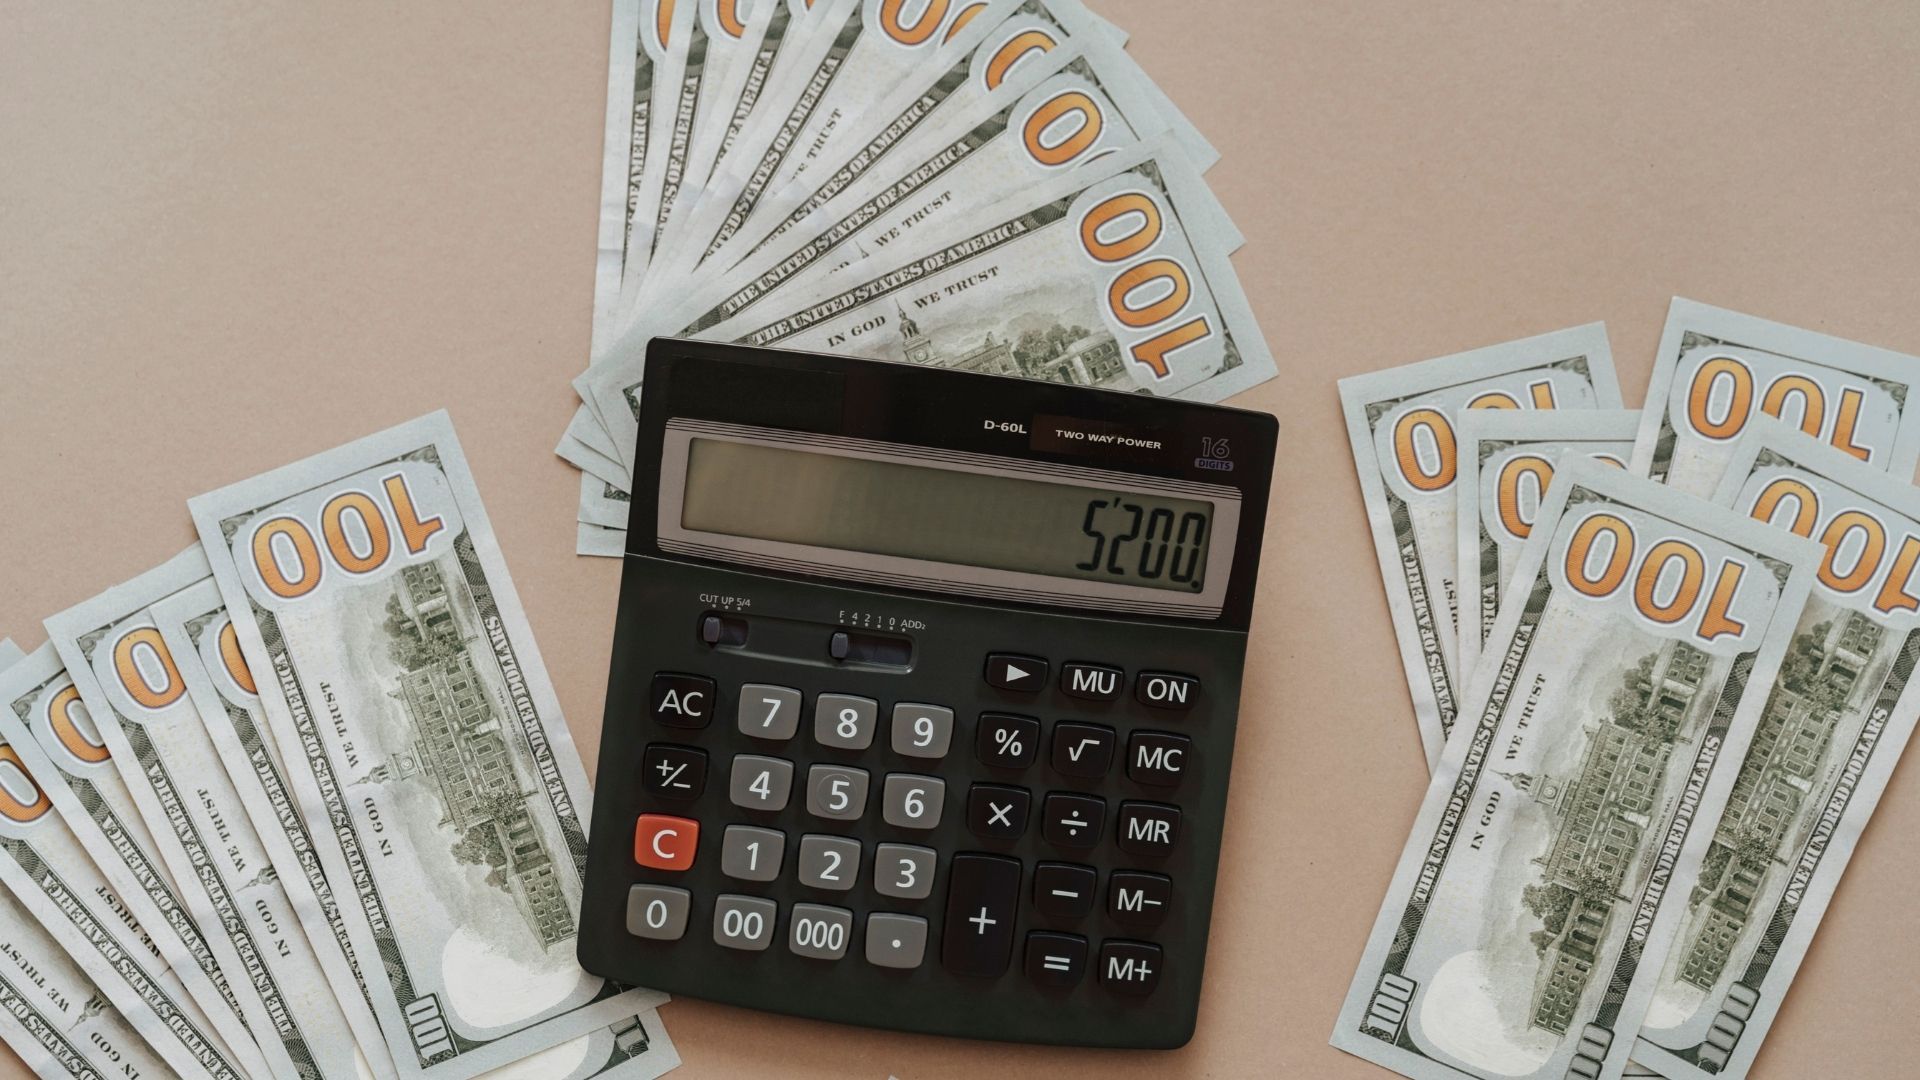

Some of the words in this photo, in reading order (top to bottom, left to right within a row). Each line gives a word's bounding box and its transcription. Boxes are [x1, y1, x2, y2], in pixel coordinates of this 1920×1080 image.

[670, 76, 699, 162] AMERICA
[734, 150, 780, 214] STATES
[772, 127, 794, 153] OF
[785, 55, 840, 133] AMERICA
[806, 108, 842, 160] TRUST
[846, 151, 872, 175] OF
[865, 93, 935, 159] AMERICA
[723, 284, 759, 314] THE
[755, 243, 818, 292] UNITED
[813, 200, 881, 252] STATES
[875, 186, 900, 209] OF
[894, 138, 972, 197] AMERICA
[873, 226, 900, 248] WE
[901, 190, 953, 230] TRUST
[751, 320, 789, 345] THE
[787, 291, 855, 331] UNITED
[852, 260, 924, 303] STATES
[920, 251, 947, 272] OF
[943, 216, 1027, 263] AMERICA
[1081, 192, 1211, 378] 100
[826, 332, 846, 348] IN
[849, 314, 887, 338] GOD
[913, 290, 941, 310] WE
[943, 265, 1001, 297] TRUST
[984, 420, 1027, 434] D-60L
[1056, 429, 1084, 440] TWO
[1088, 433, 1115, 444] WAY
[1117, 437, 1162, 450] POWER
[1198, 459, 1231, 470] DIGITS
[1202, 437, 1230, 459] 16
[251, 473, 444, 598] 100
[1400, 542, 1432, 629] AMERICA
[1564, 512, 1745, 641] 100
[700, 594, 719, 603] CUT
[721, 596, 734, 605] UP
[737, 598, 750, 607] 5/4
[852, 612, 858, 620] 4
[864, 614, 871, 622] 2
[877, 616, 882, 624] 1
[889, 617, 895, 625] 0
[483, 614, 526, 700] DOLLARS
[1420, 627, 1437, 653] OF
[1072, 669, 1116, 694] MU
[1489, 620, 1533, 707] AMERICA
[272, 650, 313, 736] AMERICA
[318, 679, 348, 736] TRUST
[658, 689, 703, 716] AC
[1147, 678, 1188, 703] ON
[762, 698, 781, 727] 7
[836, 708, 858, 738] 8
[1481, 703, 1500, 729] OF
[303, 733, 321, 758] OF
[512, 695, 559, 783] HUNDRED
[913, 717, 934, 747] 9
[341, 740, 360, 767] WE
[1137, 745, 1182, 772] MC
[1454, 726, 1491, 799] STATES
[1469, 832, 1485, 851] IN
[1478, 789, 1502, 828] GOD
[1504, 734, 1524, 763] WE
[1517, 672, 1547, 731] TRUST
[146, 761, 199, 846] AMERICA
[249, 746, 298, 830] AMERICA
[311, 757, 346, 828] STATES
[547, 779, 573, 818] ONE
[749, 771, 770, 800] 4
[829, 780, 850, 810] 5
[904, 789, 925, 818] 6
[195, 785, 231, 842] TRUST
[361, 795, 385, 833] GOD
[1783, 866, 1812, 905] ONE
[1798, 784, 1852, 870] HUNDRED
[1839, 705, 1889, 787] DOLLARS
[289, 828, 307, 852] OF
[378, 837, 393, 857] IN
[652, 830, 678, 859] C
[1128, 817, 1170, 843] MR
[1427, 796, 1464, 864] UNITED
[1629, 901, 1657, 943] ONE
[1643, 816, 1691, 905] HUNDRED
[1677, 733, 1721, 819] DOLLARS
[97, 814, 160, 893] AMERICA
[188, 842, 208, 866] OF
[226, 844, 247, 872] WE
[337, 826, 372, 895] UNITED
[746, 842, 759, 871] 1
[819, 851, 842, 880] 2
[299, 849, 339, 919] STATES
[895, 859, 916, 888] 3
[1411, 864, 1436, 903] THE
[36, 872, 107, 946] AMERICA
[94, 883, 141, 933] TRUST
[151, 887, 175, 913] OF
[199, 864, 242, 935] STATES
[253, 897, 279, 935] GOD
[362, 892, 386, 933] THE
[646, 900, 667, 928] 0
[166, 907, 218, 973] STATES
[723, 909, 763, 940] 00
[796, 918, 844, 950] 000
[0, 939, 47, 988] TRUST
[98, 939, 124, 964] OF
[139, 932, 162, 958] WE
[274, 938, 291, 958] IN
[233, 931, 274, 999] UNITED
[1108, 957, 1152, 981] M+
[46, 987, 71, 1012] WE
[115, 956, 176, 1020] STATES
[6, 996, 30, 1020] OF
[265, 995, 293, 1036] THE
[24, 1013, 83, 1073] STATES
[89, 1029, 122, 1064] GOD
[167, 1013, 223, 1072] UNITED
[120, 1062, 140, 1080] IN
